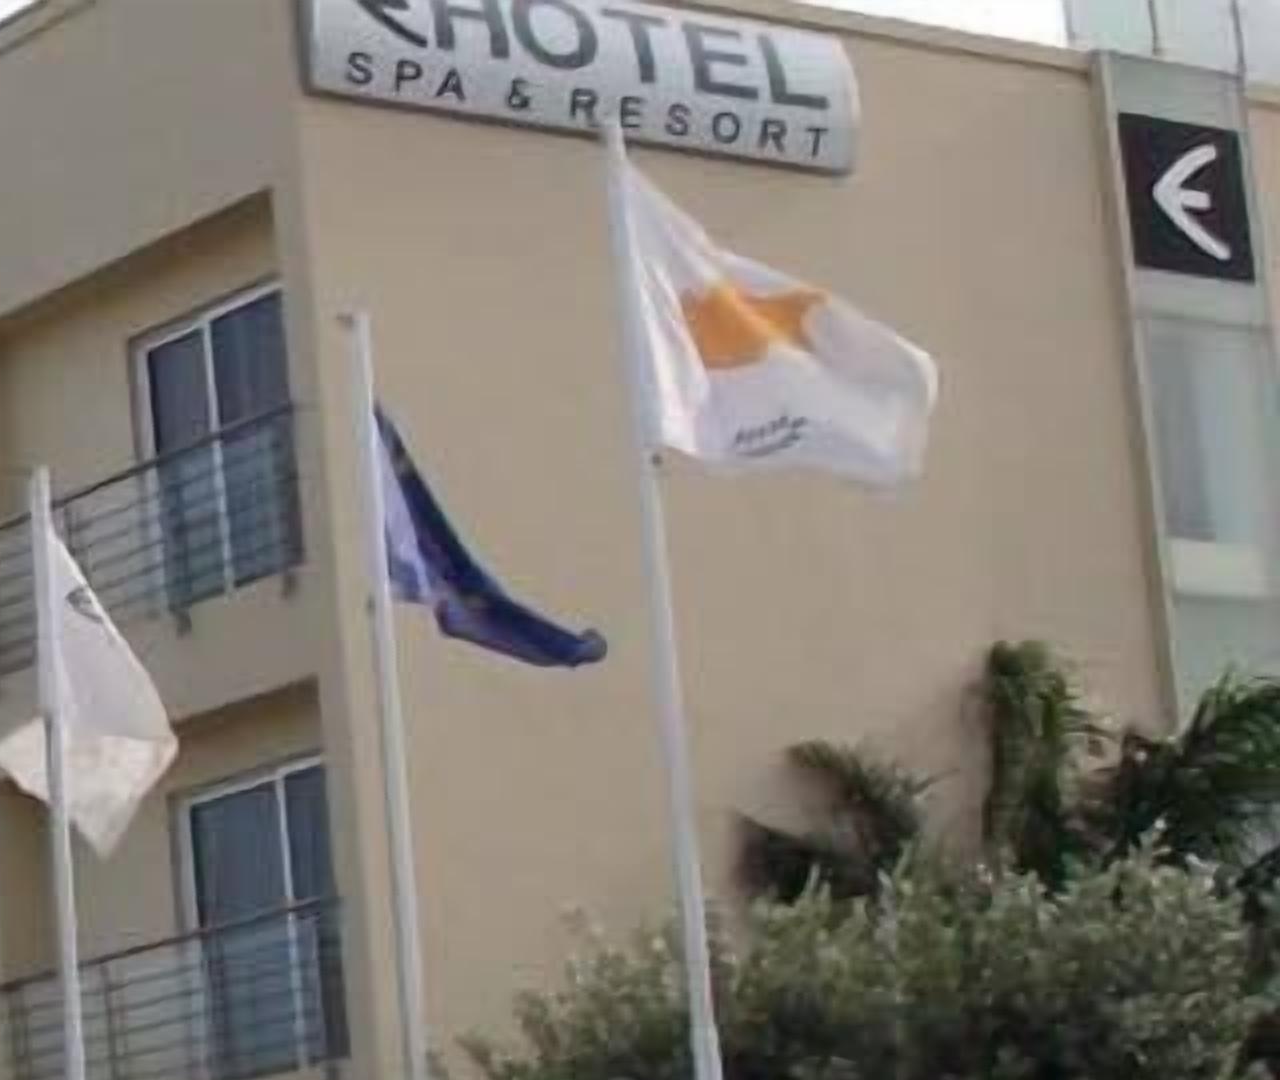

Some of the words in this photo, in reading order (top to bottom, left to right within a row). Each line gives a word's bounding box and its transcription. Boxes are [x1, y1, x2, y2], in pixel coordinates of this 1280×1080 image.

[345, 51, 466, 101] SPA
[507, 77, 532, 109] &
[569, 87, 829, 157] RESORT
